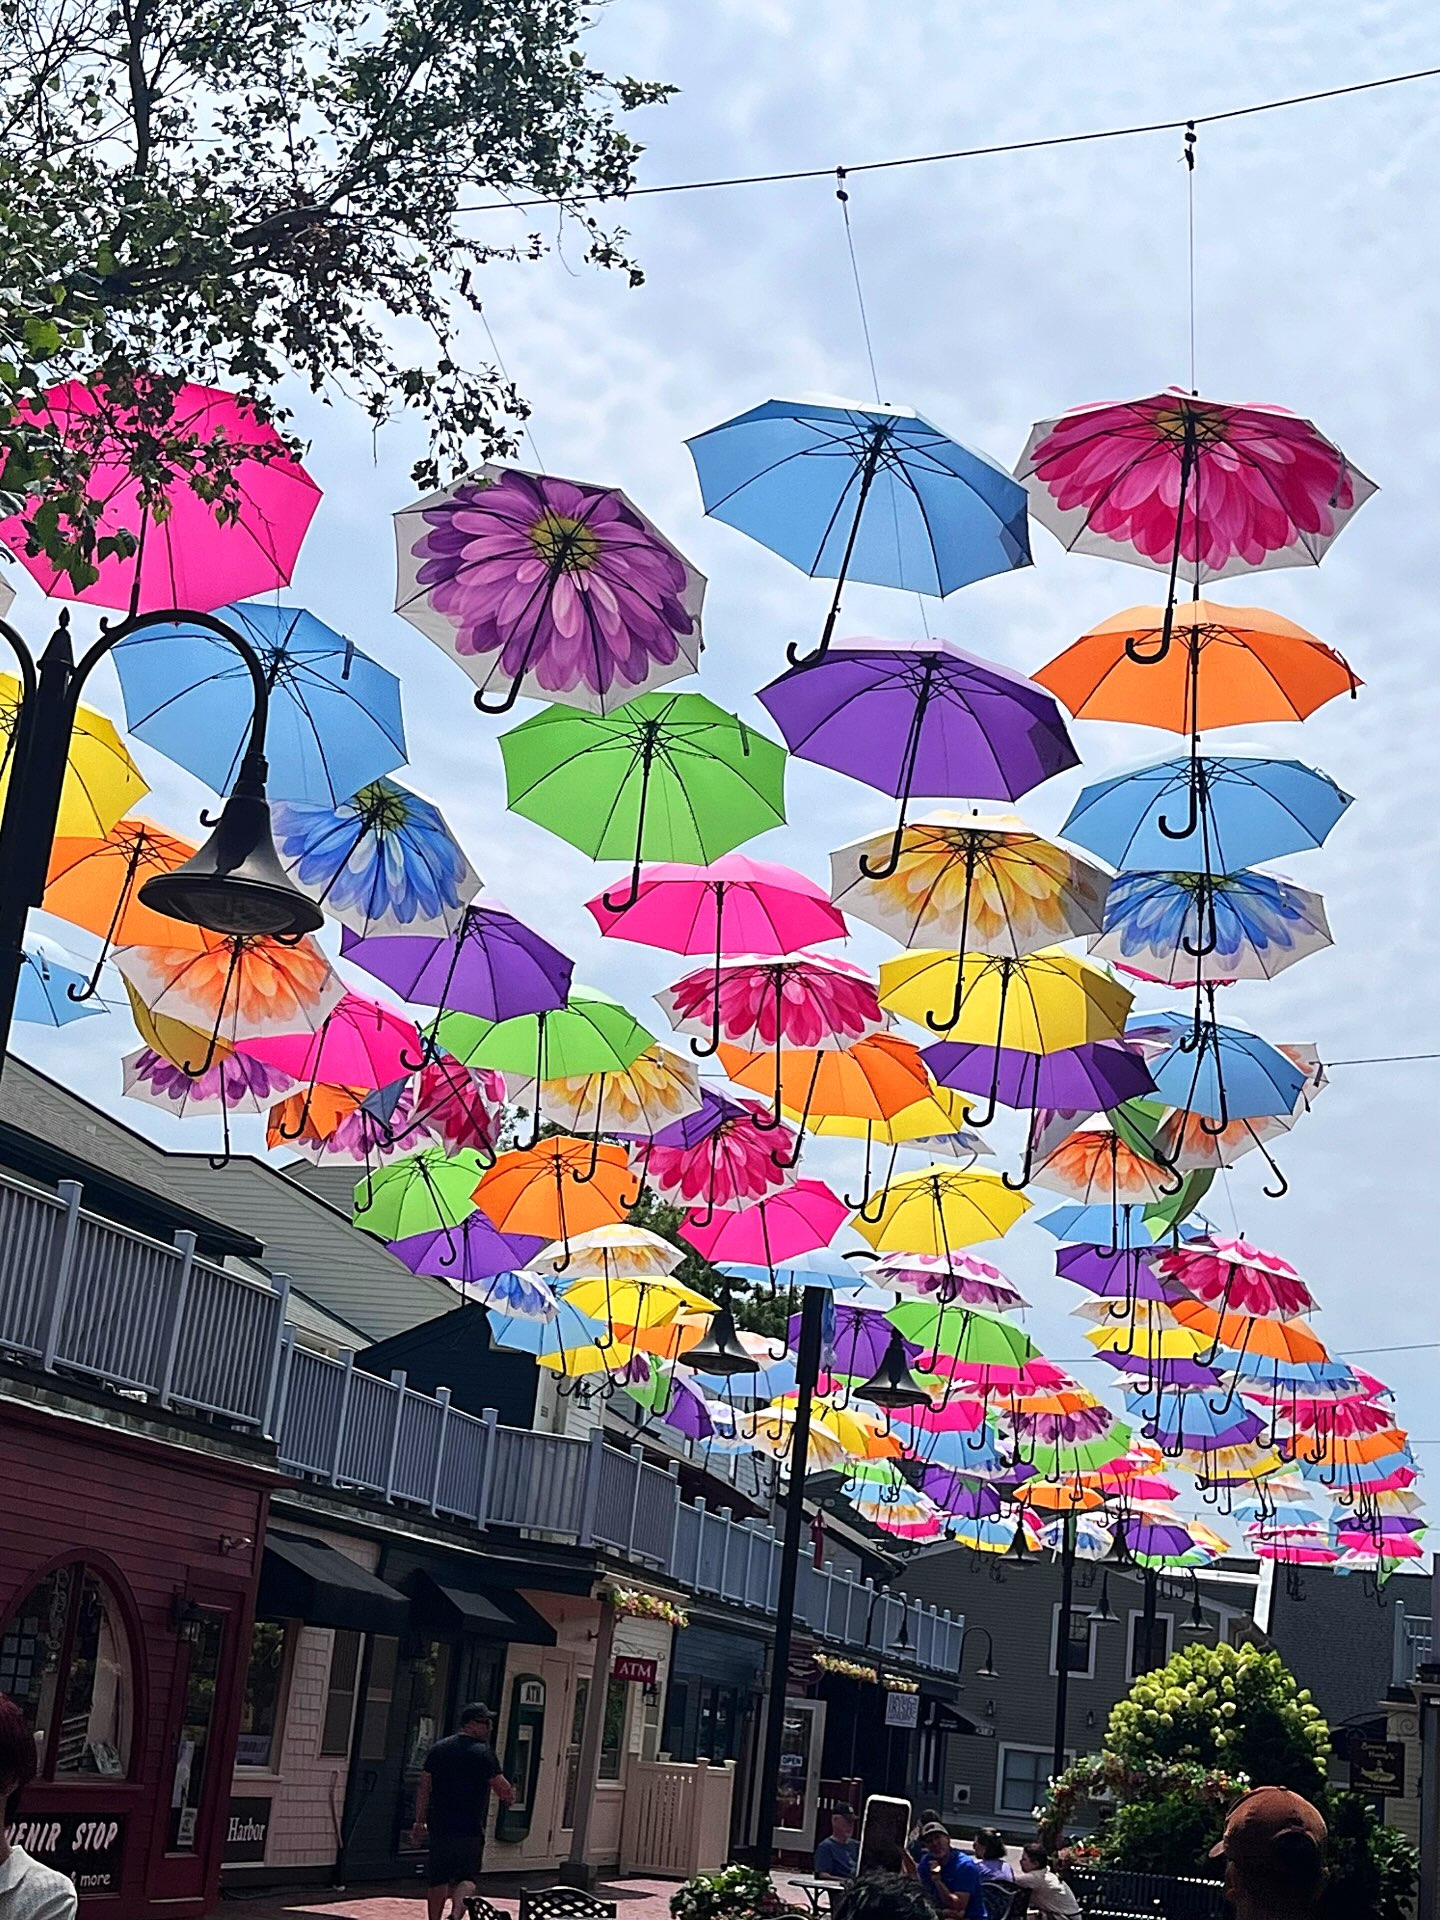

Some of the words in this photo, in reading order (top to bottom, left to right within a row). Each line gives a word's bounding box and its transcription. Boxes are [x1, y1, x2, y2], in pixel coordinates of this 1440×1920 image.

[619, 1662, 652, 1678] ATM
[526, 1685, 541, 1702] ATM
[782, 1756, 801, 1765] OPEN
[4, 1822, 61, 1852] VENIR
[72, 1822, 118, 1851] STOP
[227, 1817, 266, 1842] Harbor
[80, 1874, 111, 1887] more
